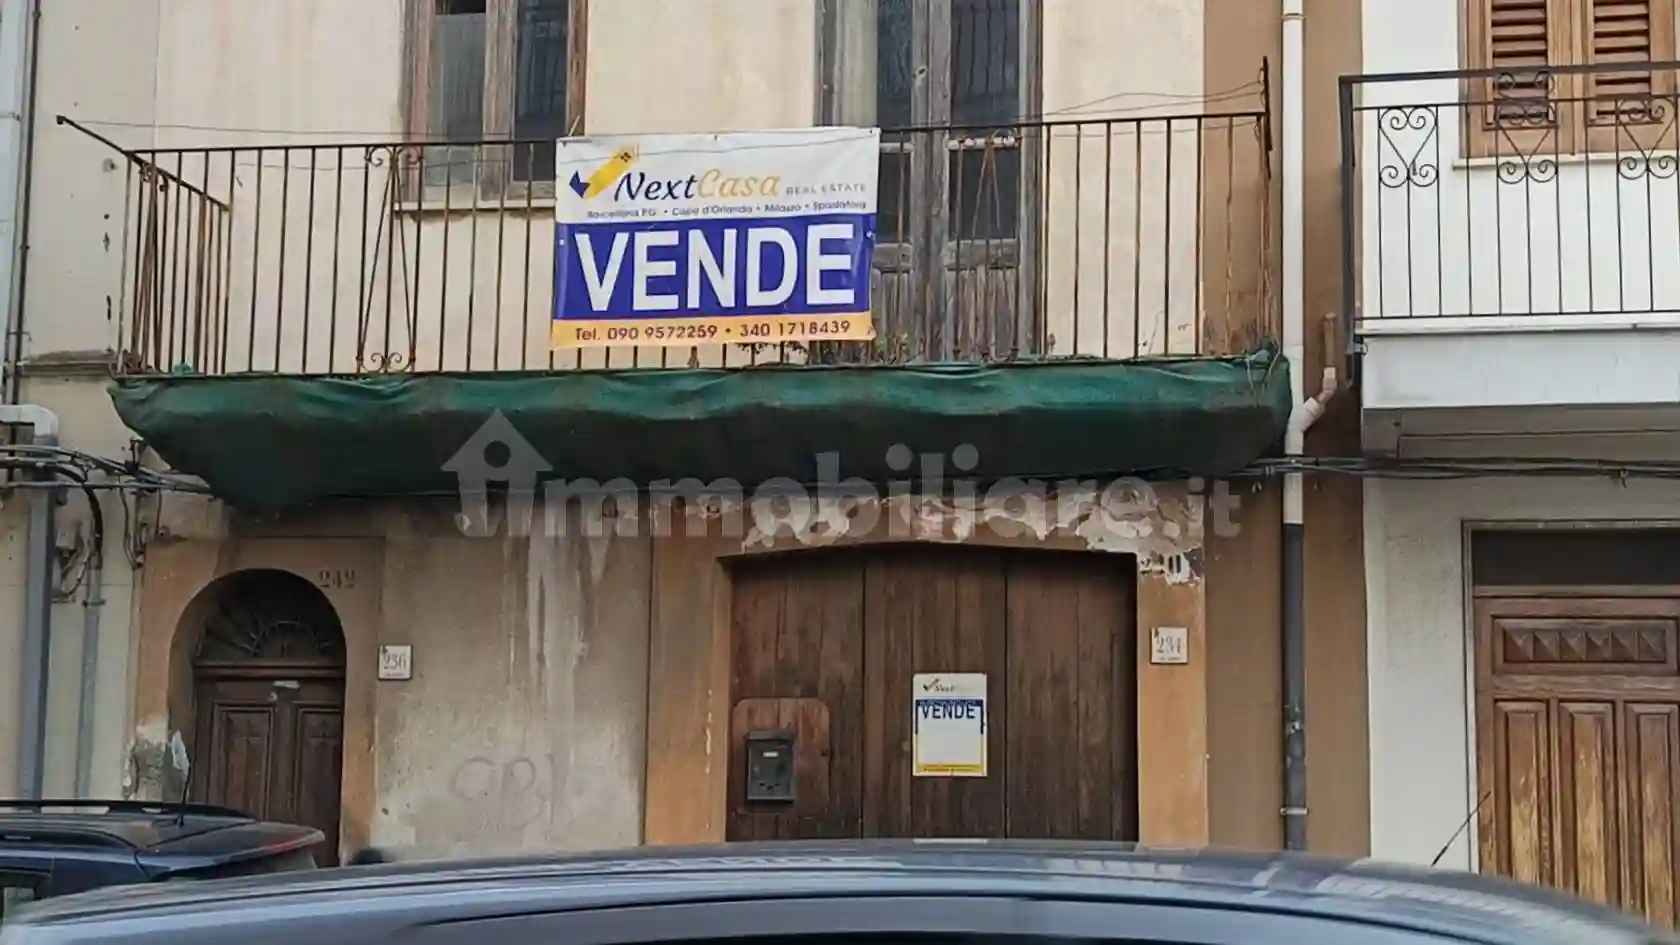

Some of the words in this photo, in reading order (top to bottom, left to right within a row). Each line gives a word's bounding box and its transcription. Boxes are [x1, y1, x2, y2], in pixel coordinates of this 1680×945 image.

[613, 167, 781, 202] NextCasa
[786, 185, 816, 196] REAL
[821, 183, 867, 193] ESTATE
[574, 224, 855, 312] VENDE
[575, 327, 600, 341] Tel.
[607, 327, 639, 341] 090
[644, 324, 718, 340] 9572259
[740, 323, 770, 337] 340
[778, 320, 851, 337] 1718439
[921, 699, 977, 720] VENDE
